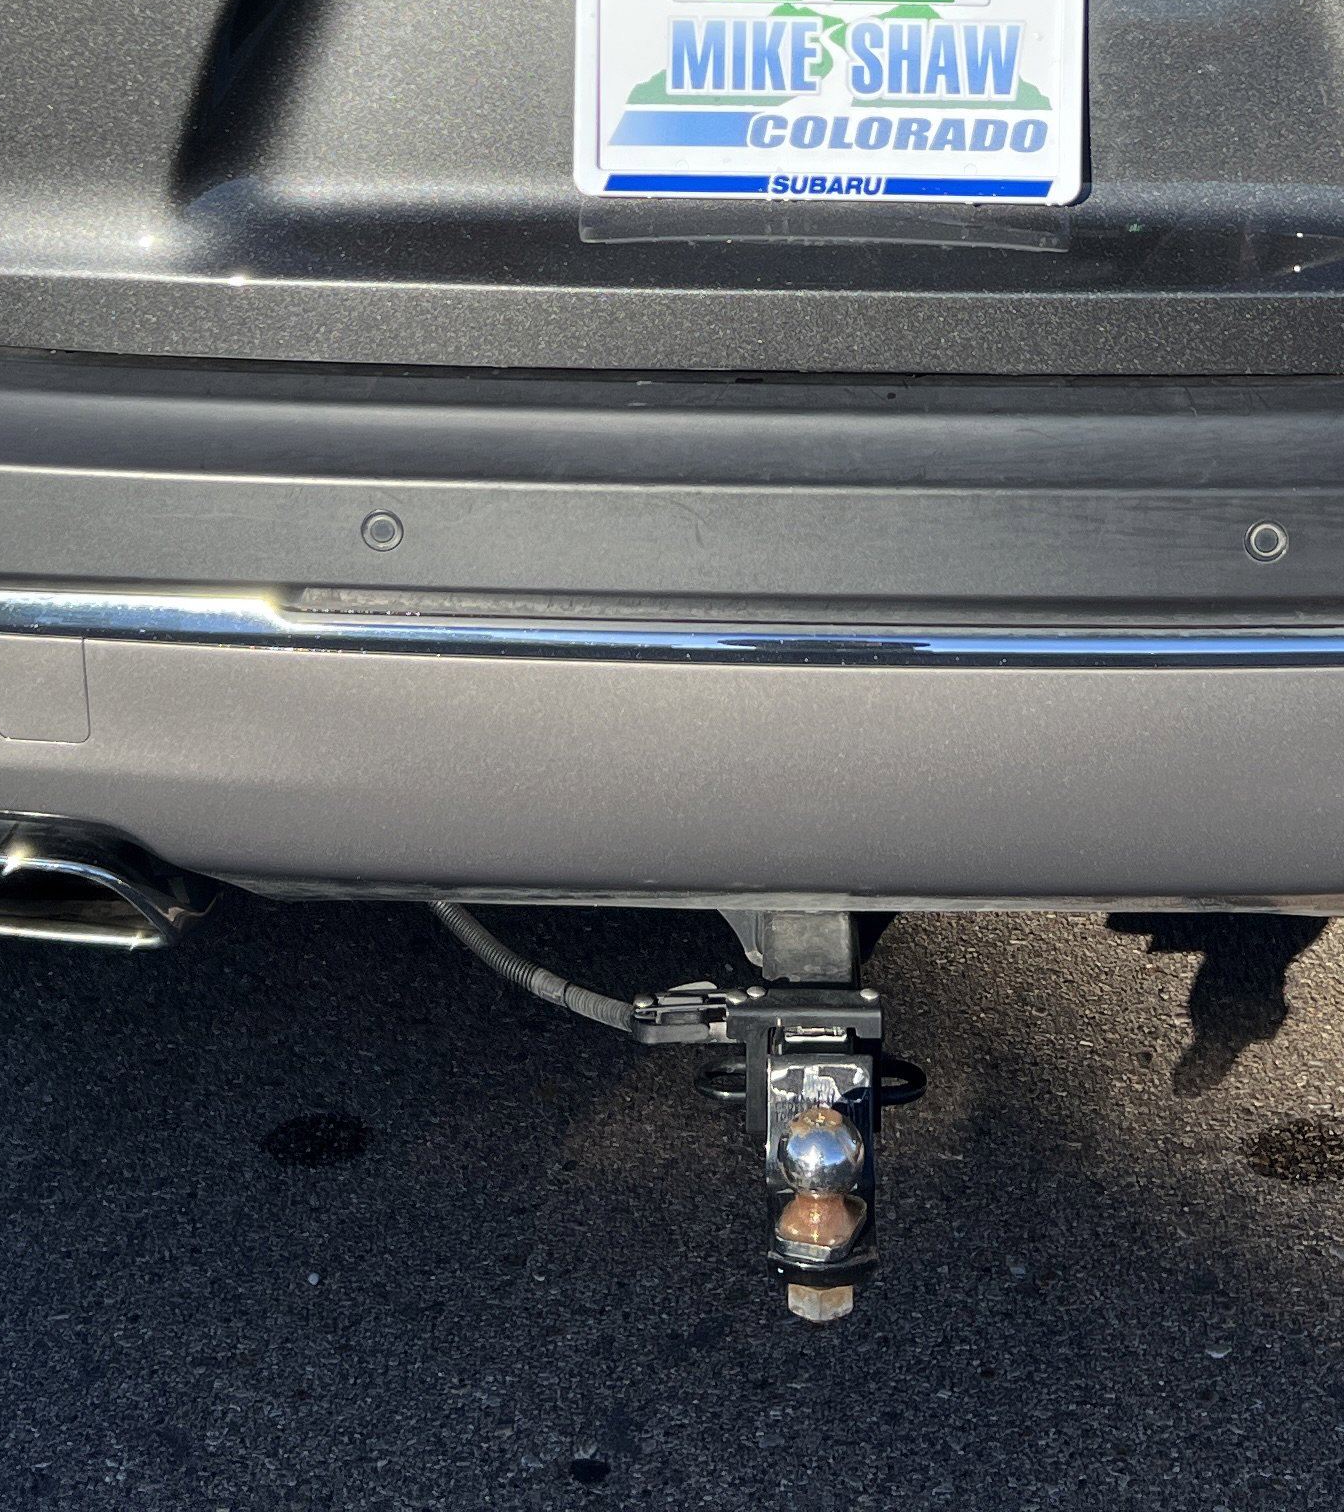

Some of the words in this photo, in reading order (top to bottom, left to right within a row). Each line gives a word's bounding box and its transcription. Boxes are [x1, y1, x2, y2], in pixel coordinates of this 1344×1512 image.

[670, 19, 821, 92] MIKE
[849, 21, 1021, 96] SHAW
[749, 113, 1048, 153] COLORADO
[771, 174, 885, 196] SUBARU
